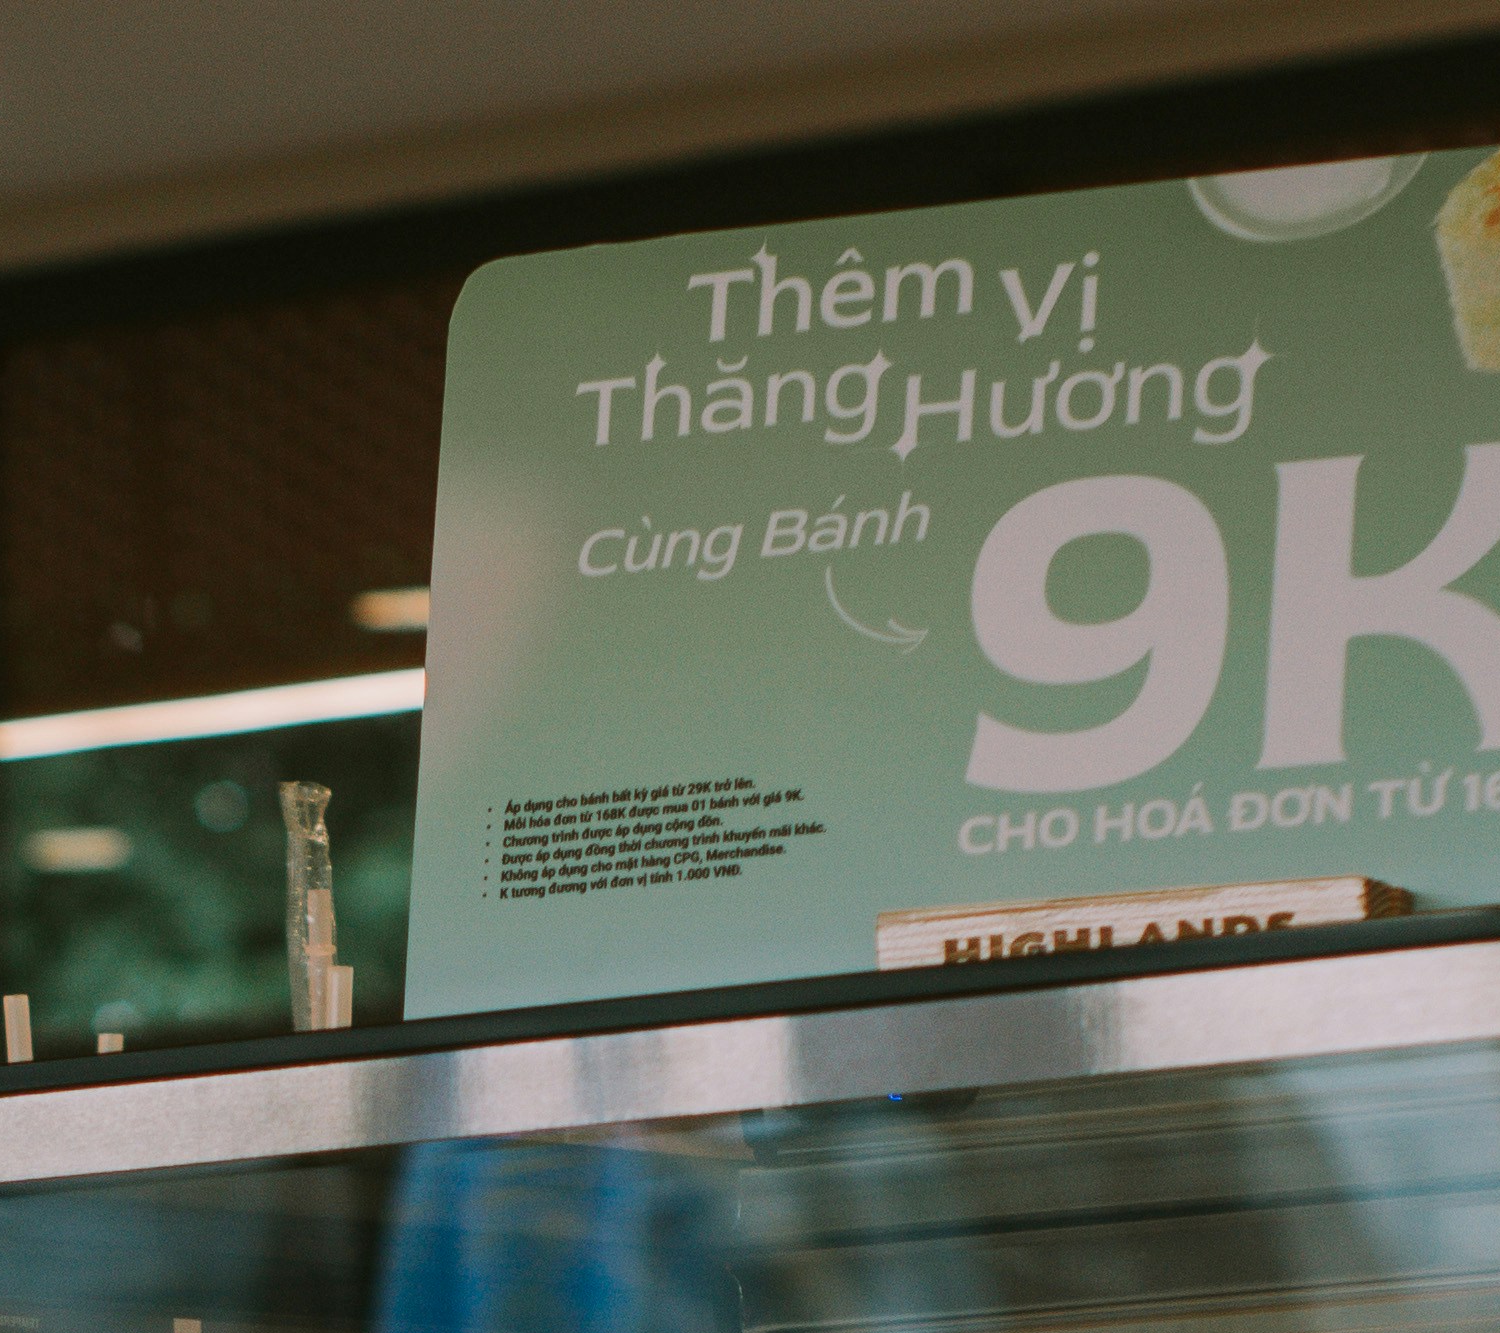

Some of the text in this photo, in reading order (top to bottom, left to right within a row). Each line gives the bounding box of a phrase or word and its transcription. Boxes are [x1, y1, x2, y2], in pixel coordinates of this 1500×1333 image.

[687, 242, 1100, 352] Thêm Vị
[575, 336, 1274, 460] Thăng Hương
[577, 492, 931, 582] Cùng Bánh
[505, 800, 521, 816] Áp
[524, 800, 553, 813] dụng
[556, 796, 577, 809] cho
[580, 791, 609, 806] bánh
[687, 781, 711, 795] 29K
[554, 813, 577, 826] đơn
[596, 807, 627, 820] 168K
[662, 803, 688, 815] mua
[691, 800, 706, 812] 01
[709, 795, 739, 810] bánh
[957, 807, 1080, 855] CHO
[1092, 782, 1213, 845] HOÁ
[1229, 782, 1353, 832] ĐƠN
[1369, 759, 1453, 818] TỪ
[502, 852, 533, 866] Được
[536, 850, 550, 863] áp
[553, 847, 582, 861] dụng
[644, 835, 689, 850] chương
[692, 832, 719, 845] trình
[503, 834, 549, 849] Chương
[552, 829, 580, 844] trình
[500, 888, 509, 900] K
[512, 885, 546, 898] tương
[610, 875, 634, 888] đơn
[676, 867, 710, 881] 1.000
[501, 869, 539, 883] Không
[541, 866, 556, 880] áp
[558, 863, 588, 877] dụng
[591, 860, 613, 873] cho
